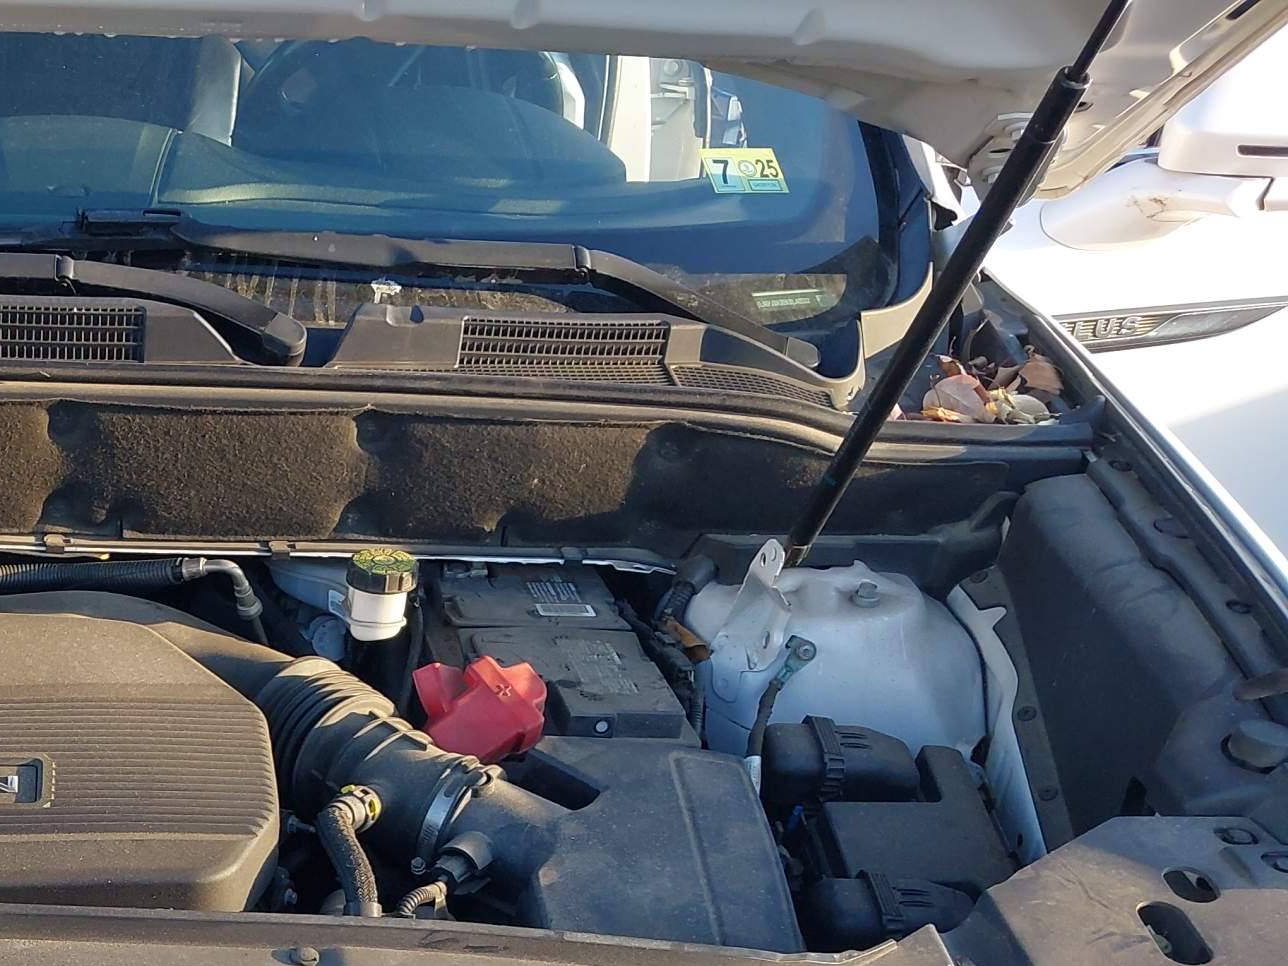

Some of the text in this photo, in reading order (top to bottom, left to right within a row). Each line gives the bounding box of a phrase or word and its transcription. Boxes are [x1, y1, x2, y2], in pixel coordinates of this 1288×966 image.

[712, 159, 779, 184] 7 25
[1064, 316, 1142, 339] LUS
